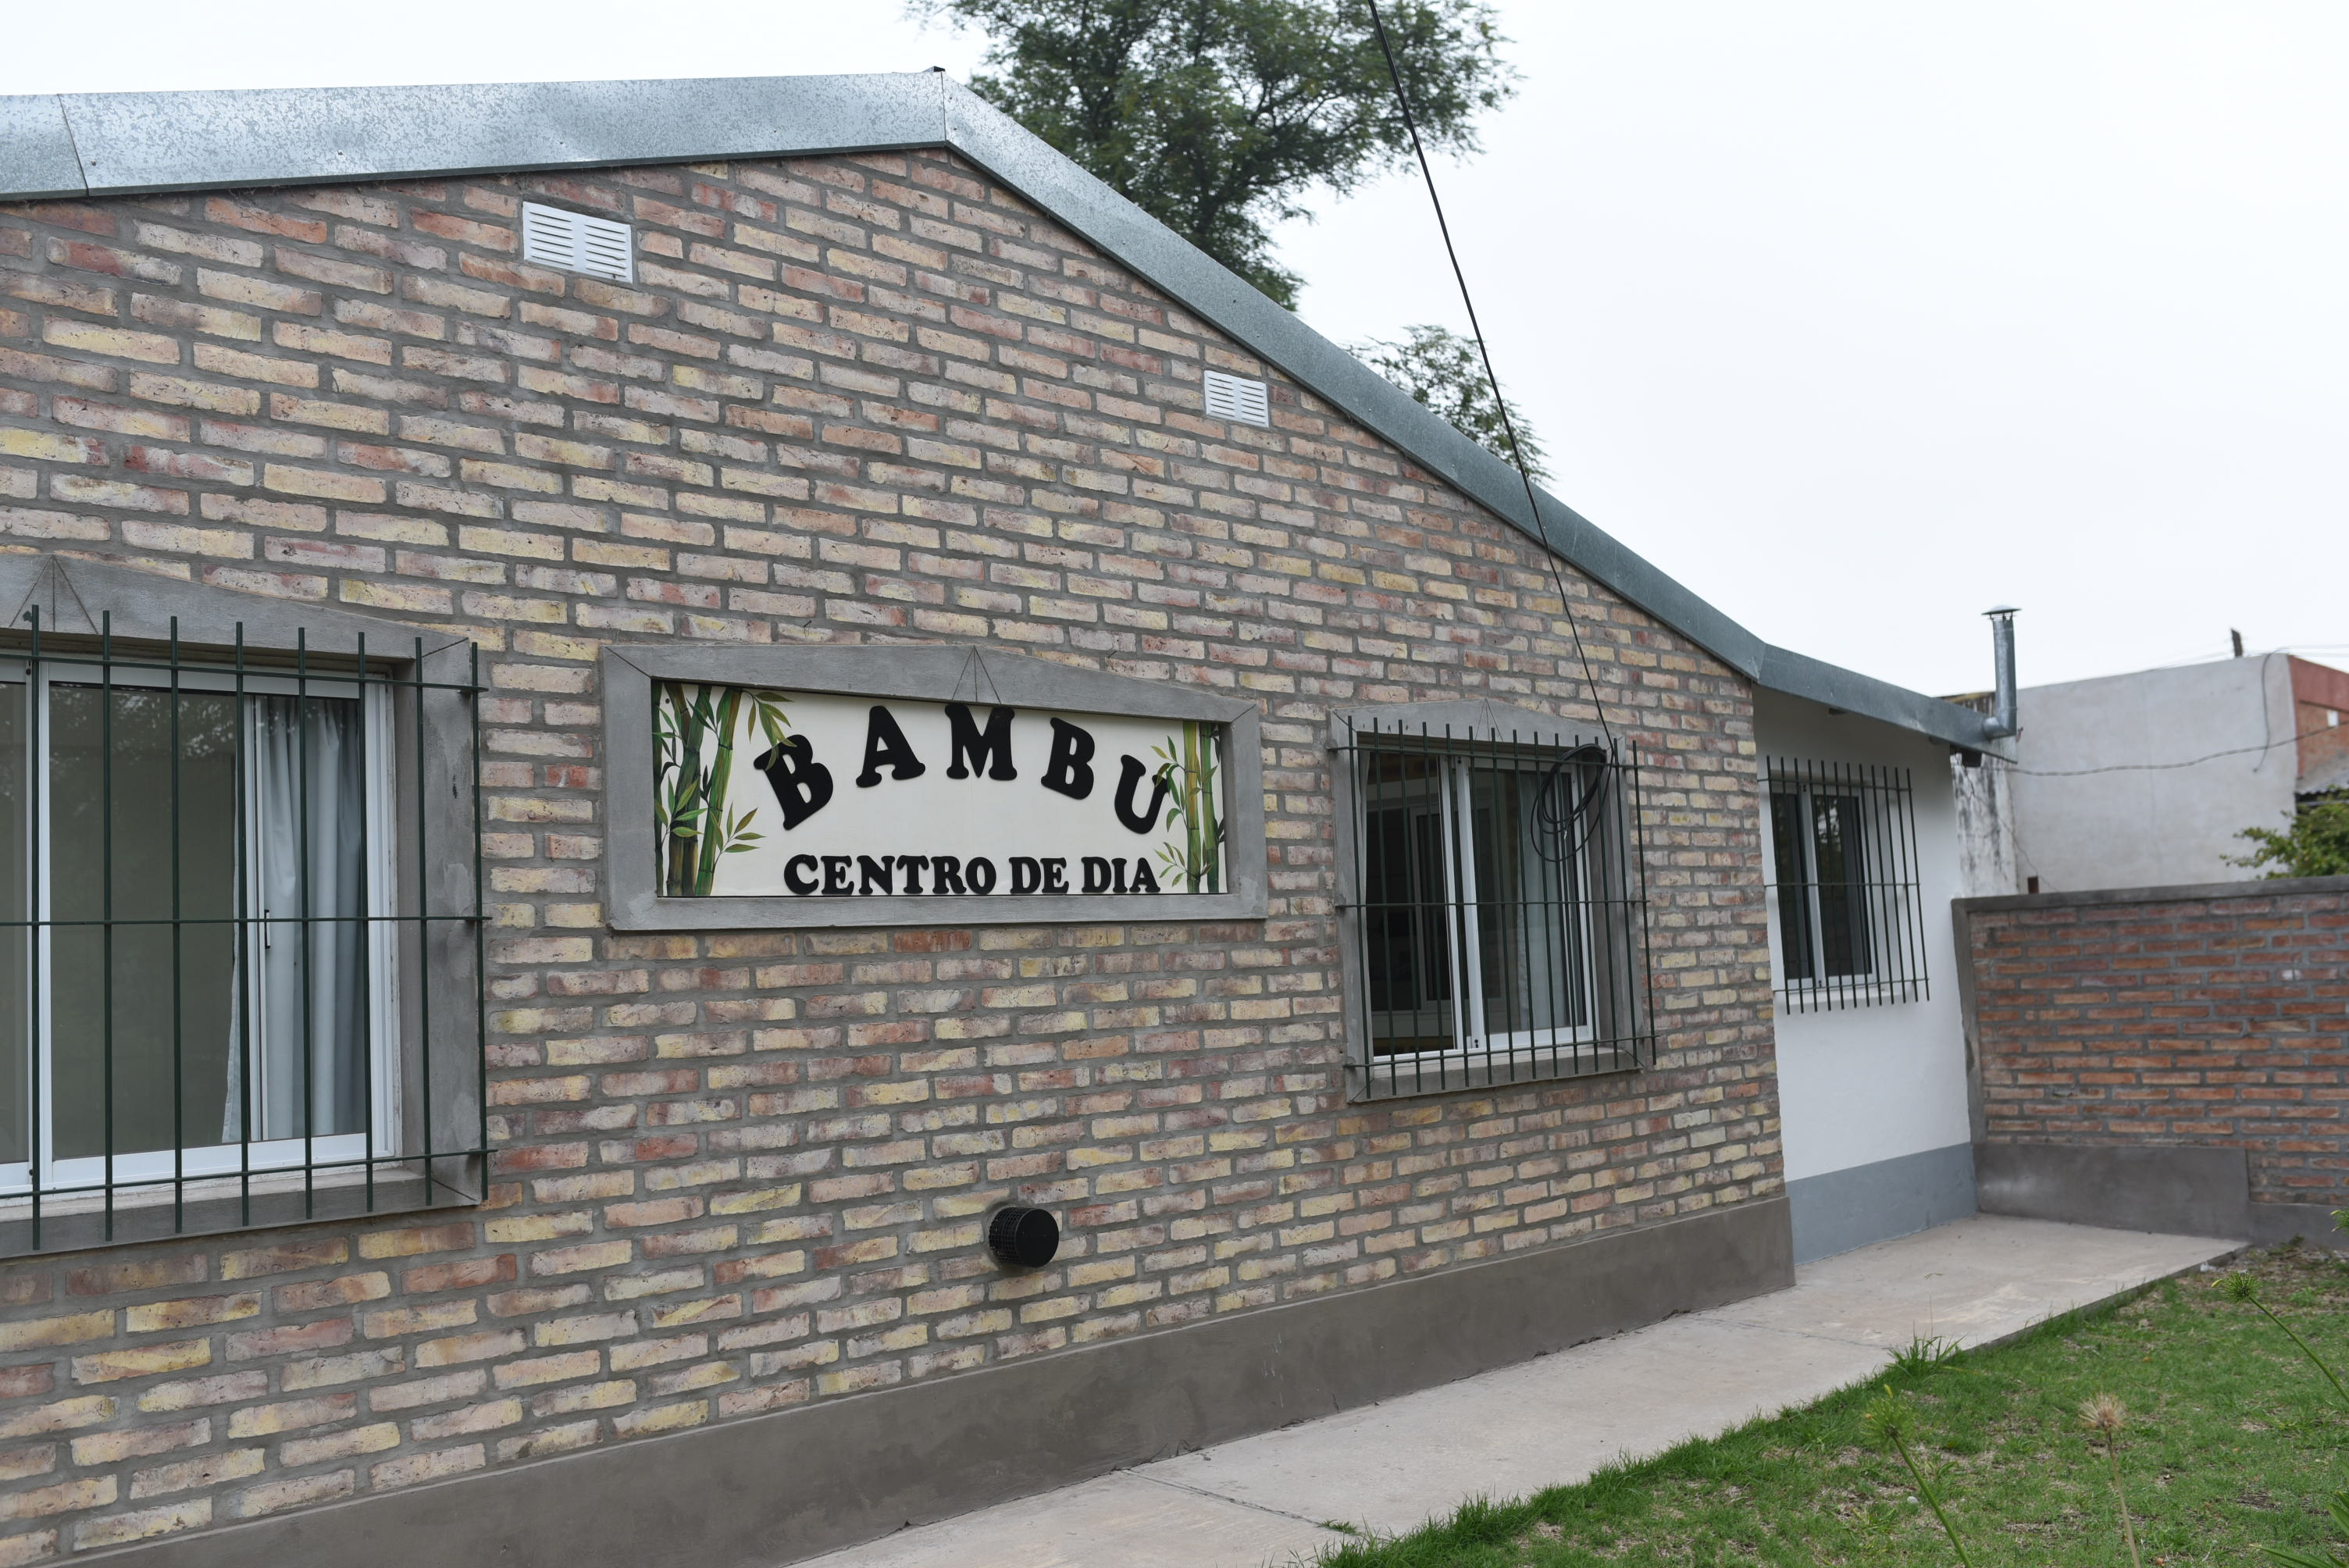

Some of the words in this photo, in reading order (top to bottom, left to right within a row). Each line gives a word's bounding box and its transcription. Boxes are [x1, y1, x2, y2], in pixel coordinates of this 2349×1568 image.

[753, 704, 1171, 835] BAMBU
[783, 853, 996, 896] CENTRO
[1009, 855, 1070, 895] DE
[1081, 856, 1161, 894] DIA
